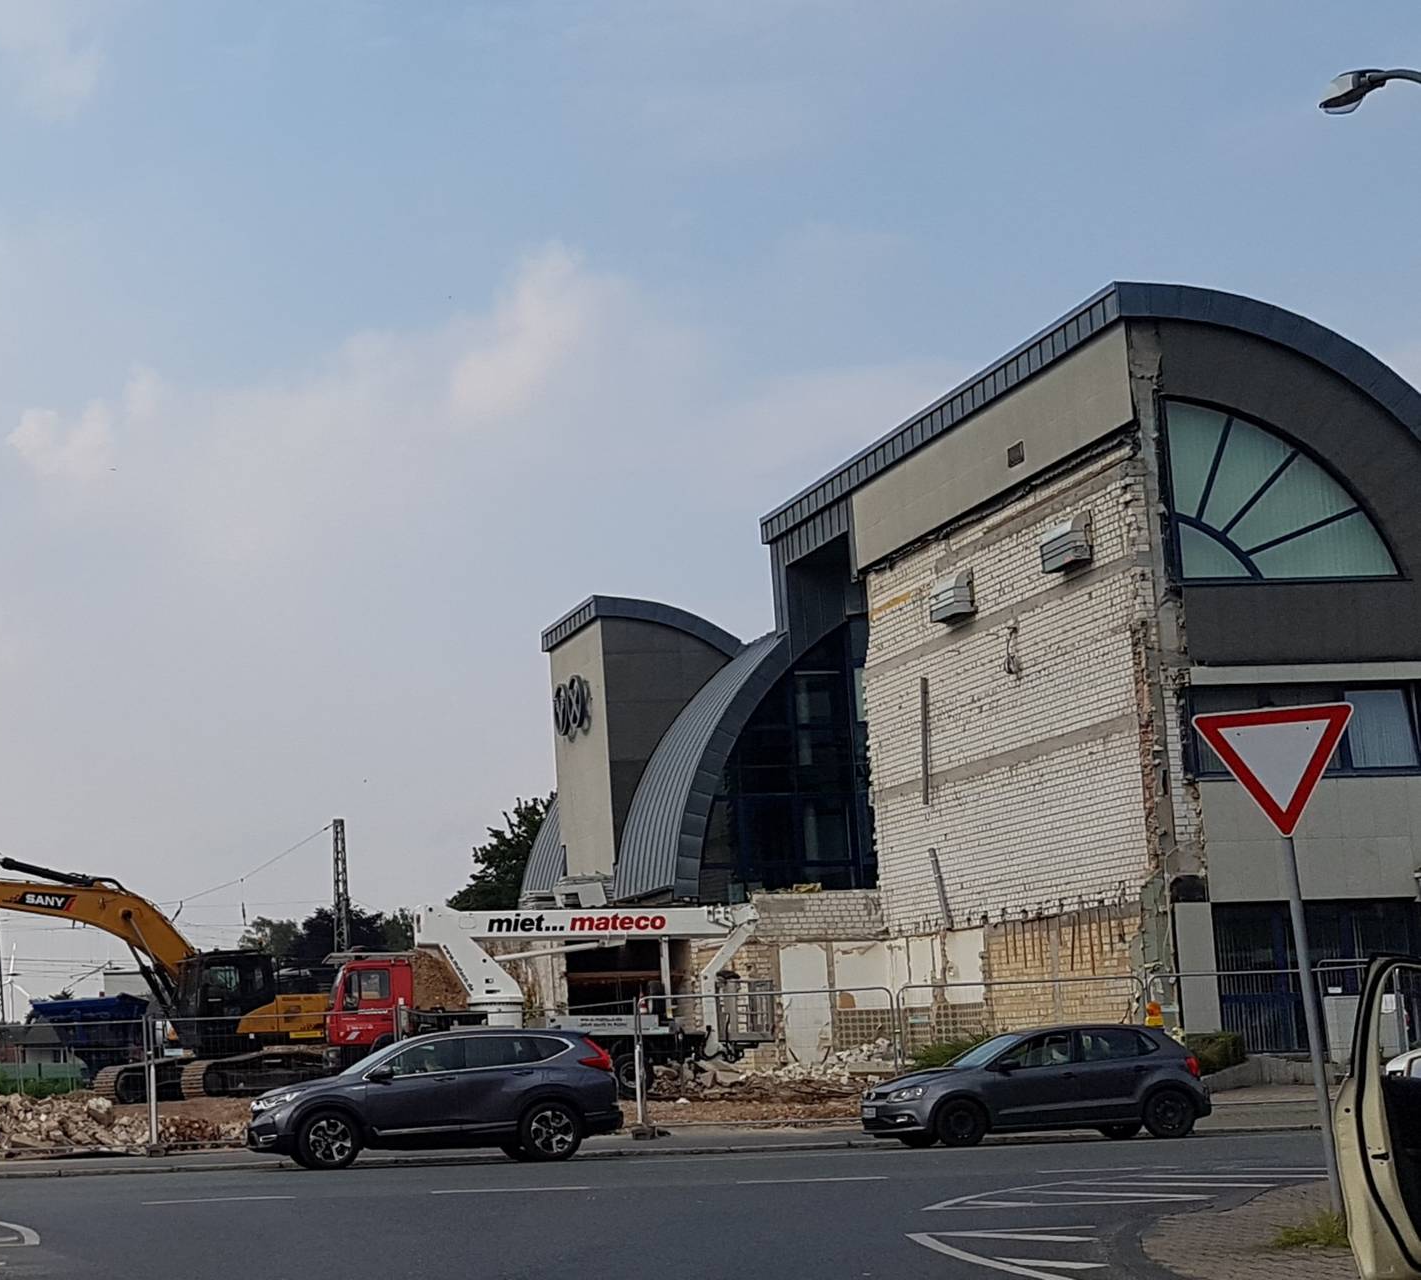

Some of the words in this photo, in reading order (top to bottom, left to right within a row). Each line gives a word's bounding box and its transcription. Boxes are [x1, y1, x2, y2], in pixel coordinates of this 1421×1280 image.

[25, 893, 65, 907] SANY
[487, 913, 565, 932] miet...
[569, 913, 666, 931] mateco
